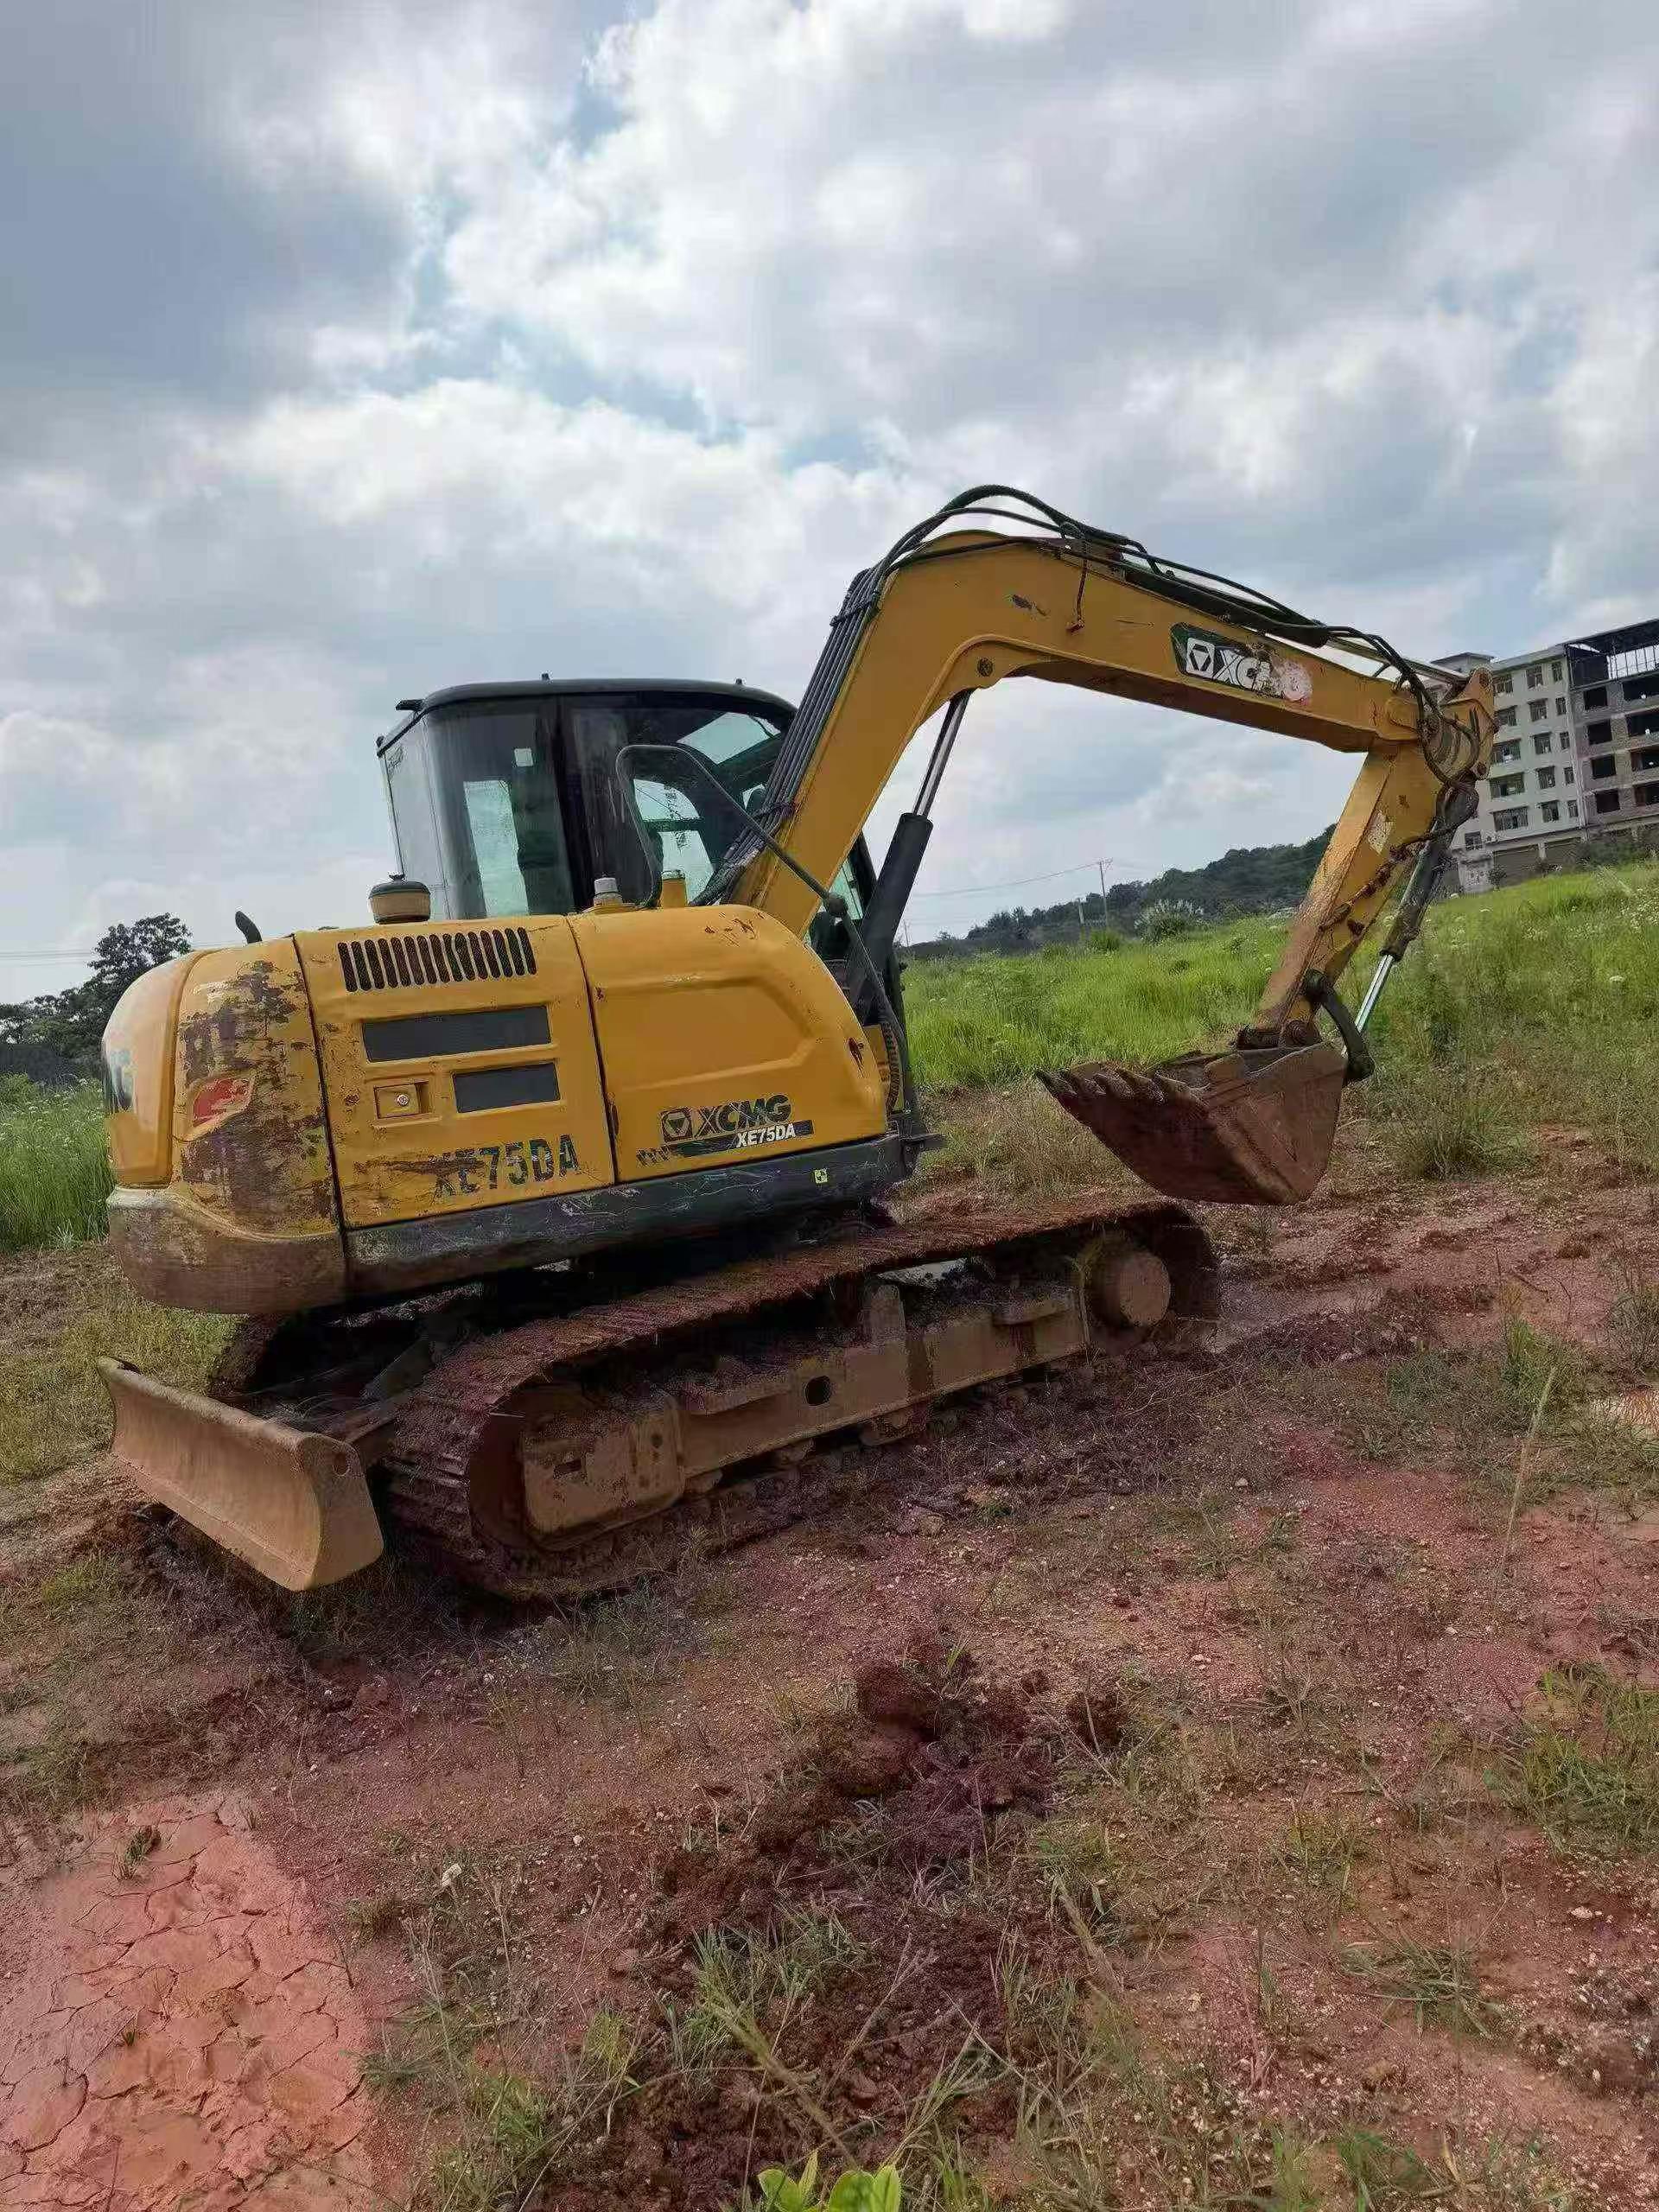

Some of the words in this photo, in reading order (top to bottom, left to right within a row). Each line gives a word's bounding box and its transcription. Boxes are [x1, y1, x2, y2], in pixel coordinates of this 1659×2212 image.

[1212, 648, 1303, 702] XC
[693, 1094, 791, 1138] XCMG
[735, 1122, 797, 1148] XE75DA
